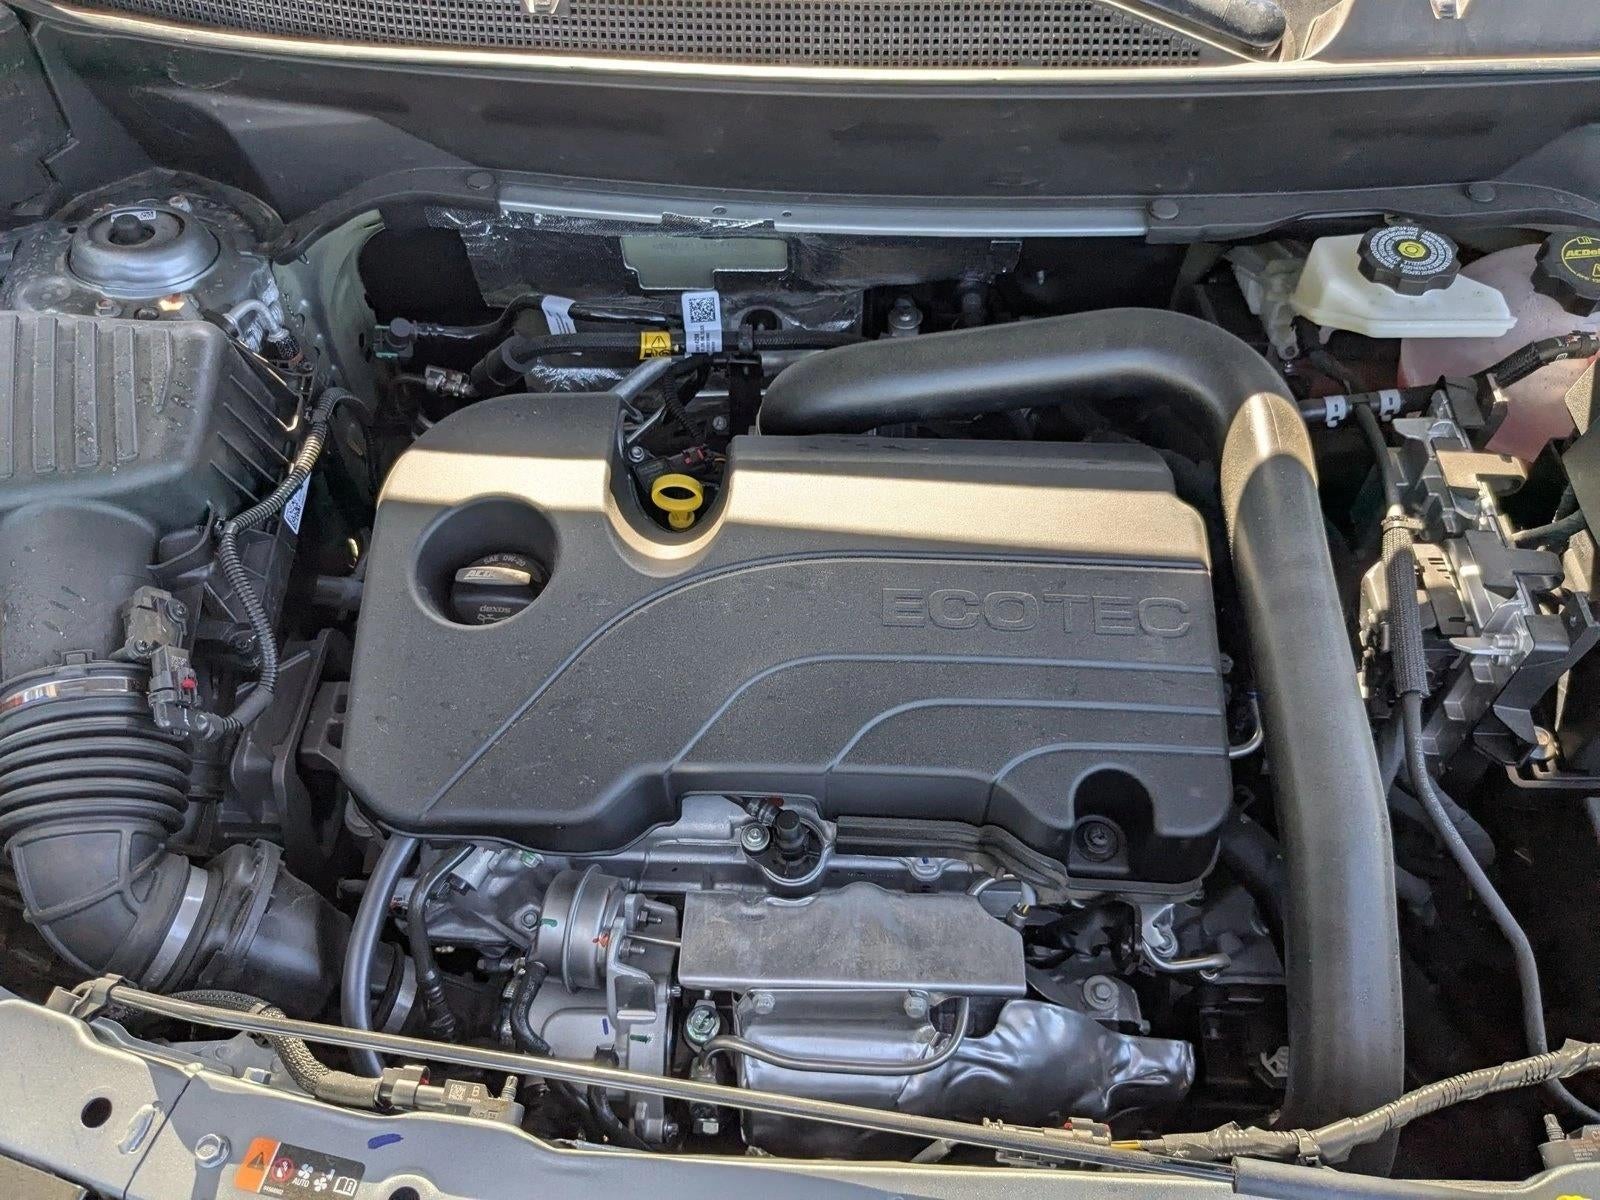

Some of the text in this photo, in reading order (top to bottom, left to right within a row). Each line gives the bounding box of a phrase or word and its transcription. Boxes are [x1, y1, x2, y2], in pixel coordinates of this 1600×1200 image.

[480, 605, 511, 613] dexos
[882, 588, 1191, 638] ECOTEC
[291, 1177, 310, 1187] AUTO
